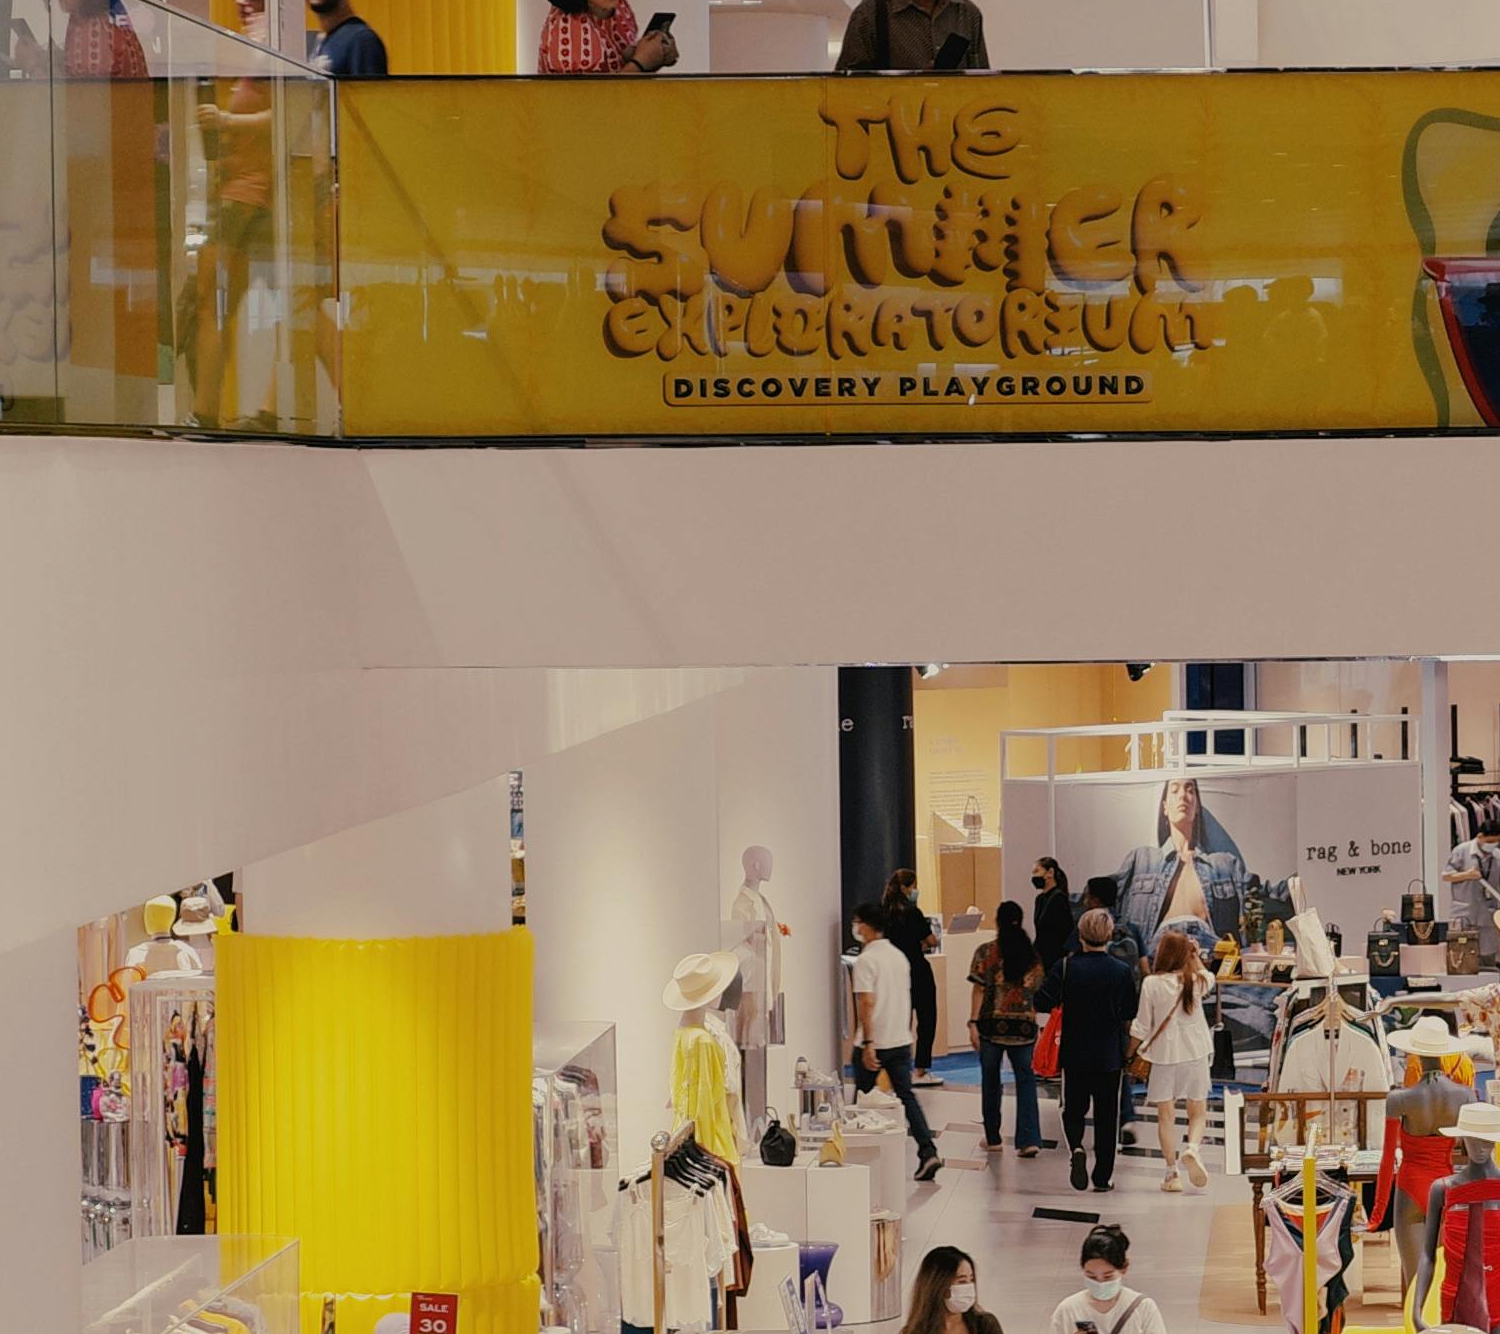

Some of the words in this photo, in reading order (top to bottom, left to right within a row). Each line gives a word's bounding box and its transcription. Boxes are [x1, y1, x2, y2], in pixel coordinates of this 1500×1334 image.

[820, 94, 1020, 185] THE
[602, 171, 1206, 306] SUMMER
[602, 292, 1216, 363] EXPLORATORIUM
[673, 375, 881, 399] DISCOVERY
[899, 373, 1145, 398] PLAYGROUND
[1305, 845, 1338, 863] rag
[1347, 840, 1360, 857] &
[1370, 839, 1411, 856] bone
[1336, 867, 1357, 876] NEW
[1359, 865, 1381, 874] YORK
[419, 1302, 449, 1314] SALE
[419, 1318, 448, 1334] 30
